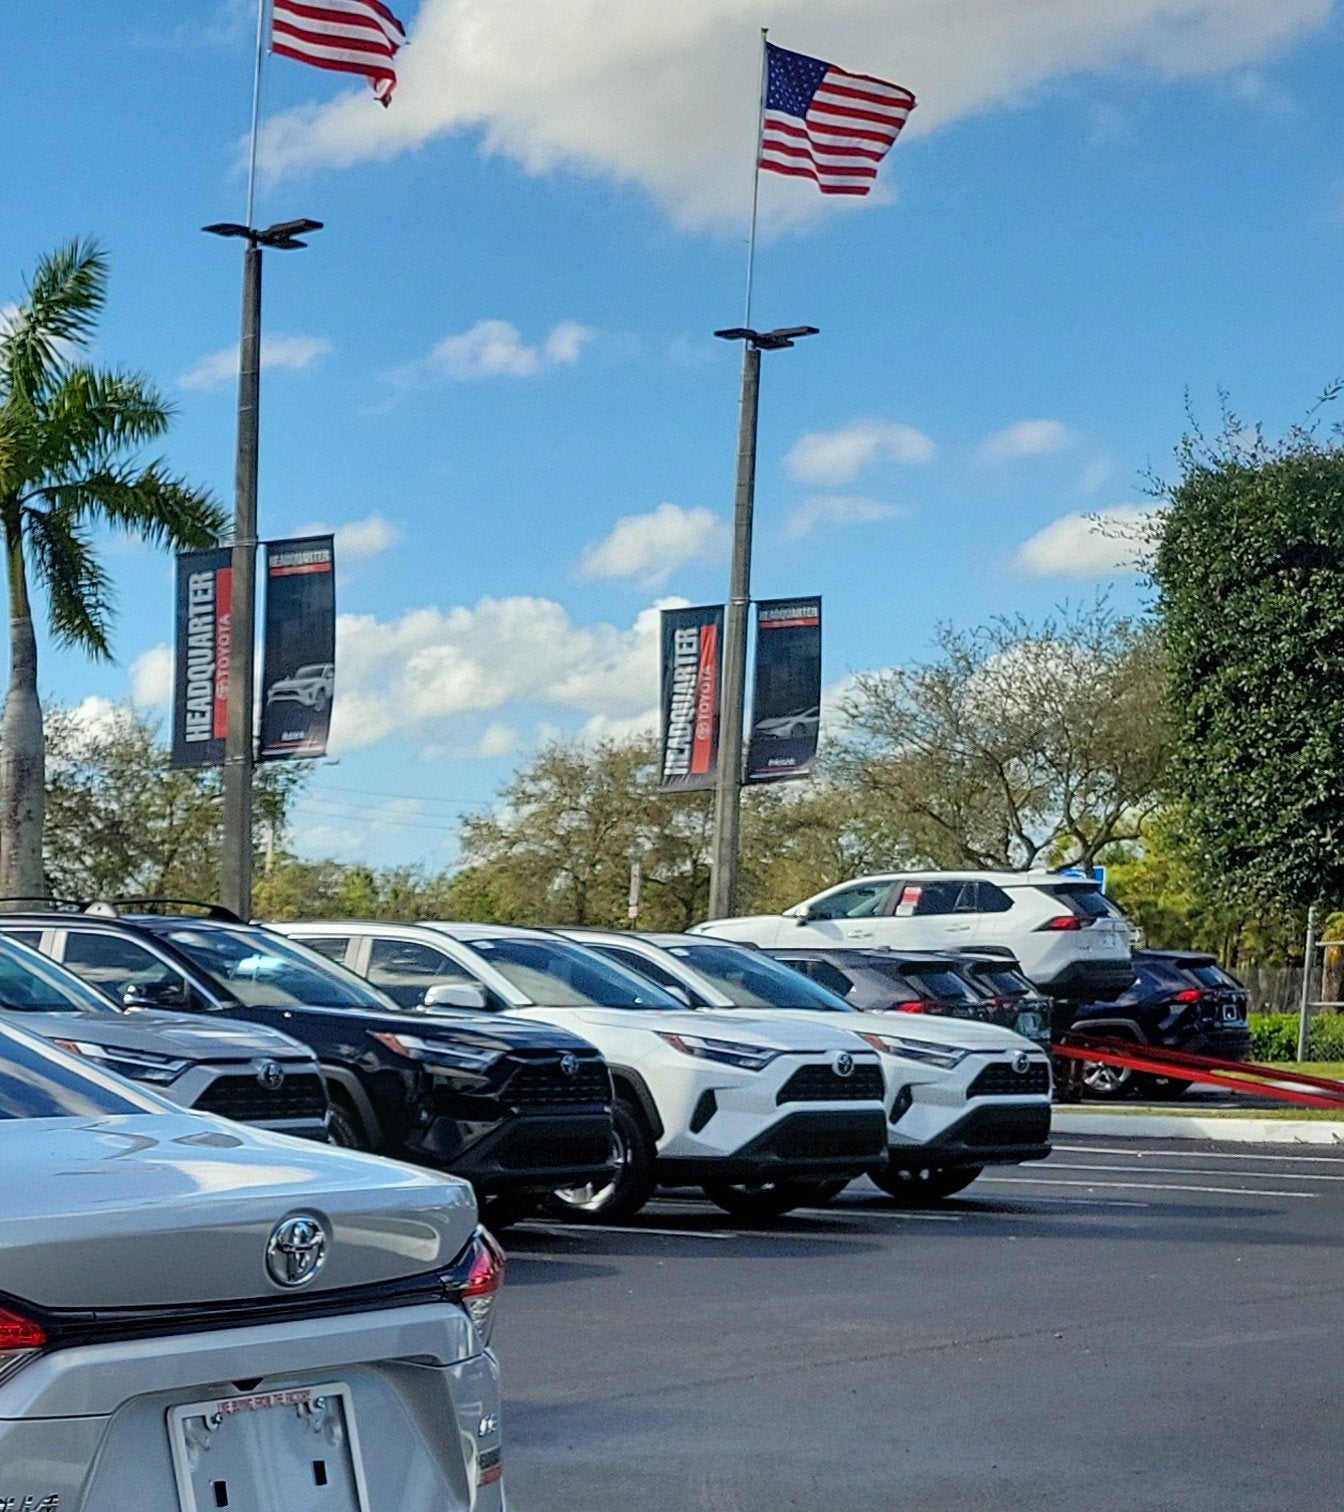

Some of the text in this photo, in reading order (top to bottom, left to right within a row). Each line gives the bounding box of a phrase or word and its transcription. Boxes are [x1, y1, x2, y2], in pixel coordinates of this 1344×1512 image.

[185, 570, 216, 743] HEADQUARTER
[217, 612, 231, 679] TOYOTA
[697, 665, 713, 721] TOYOTA
[663, 627, 699, 776] HEADQUARTER
